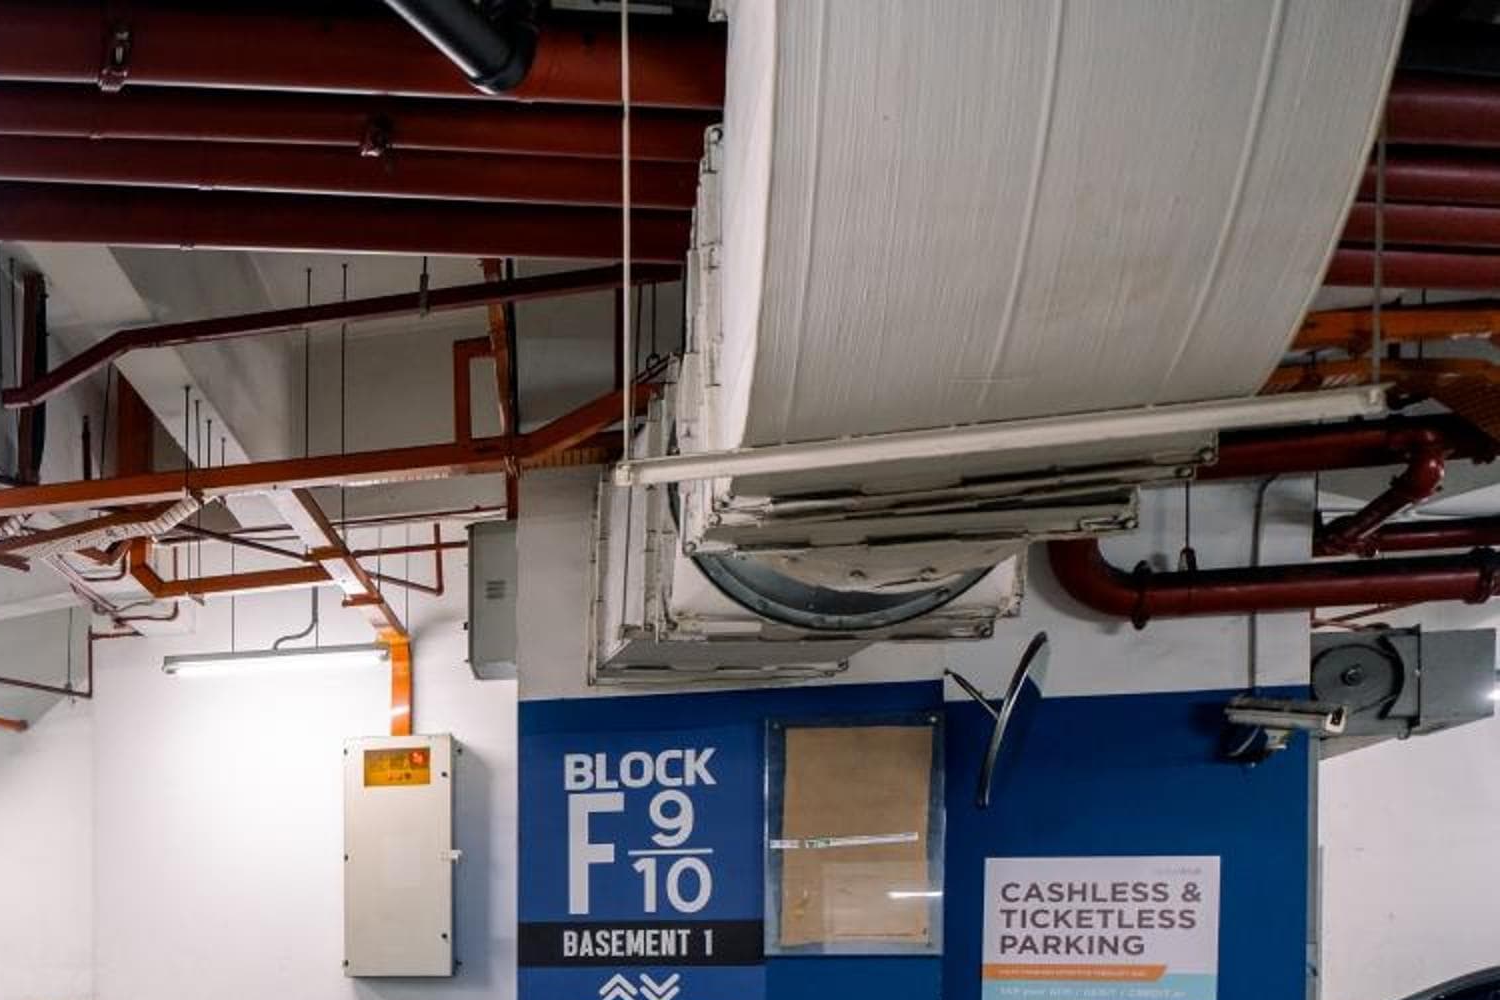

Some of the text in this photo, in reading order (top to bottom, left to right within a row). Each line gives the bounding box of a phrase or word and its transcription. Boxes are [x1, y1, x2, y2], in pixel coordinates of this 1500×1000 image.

[564, 748, 717, 792] BLOCK
[648, 790, 695, 848] 9
[568, 792, 625, 915] F
[631, 857, 713, 914] 10
[1000, 881, 1202, 904] CASHLESS &
[999, 907, 1197, 930] TICKETLESS
[563, 929, 713, 958] BASEMENT 1
[1000, 934, 1146, 957] PARKING
